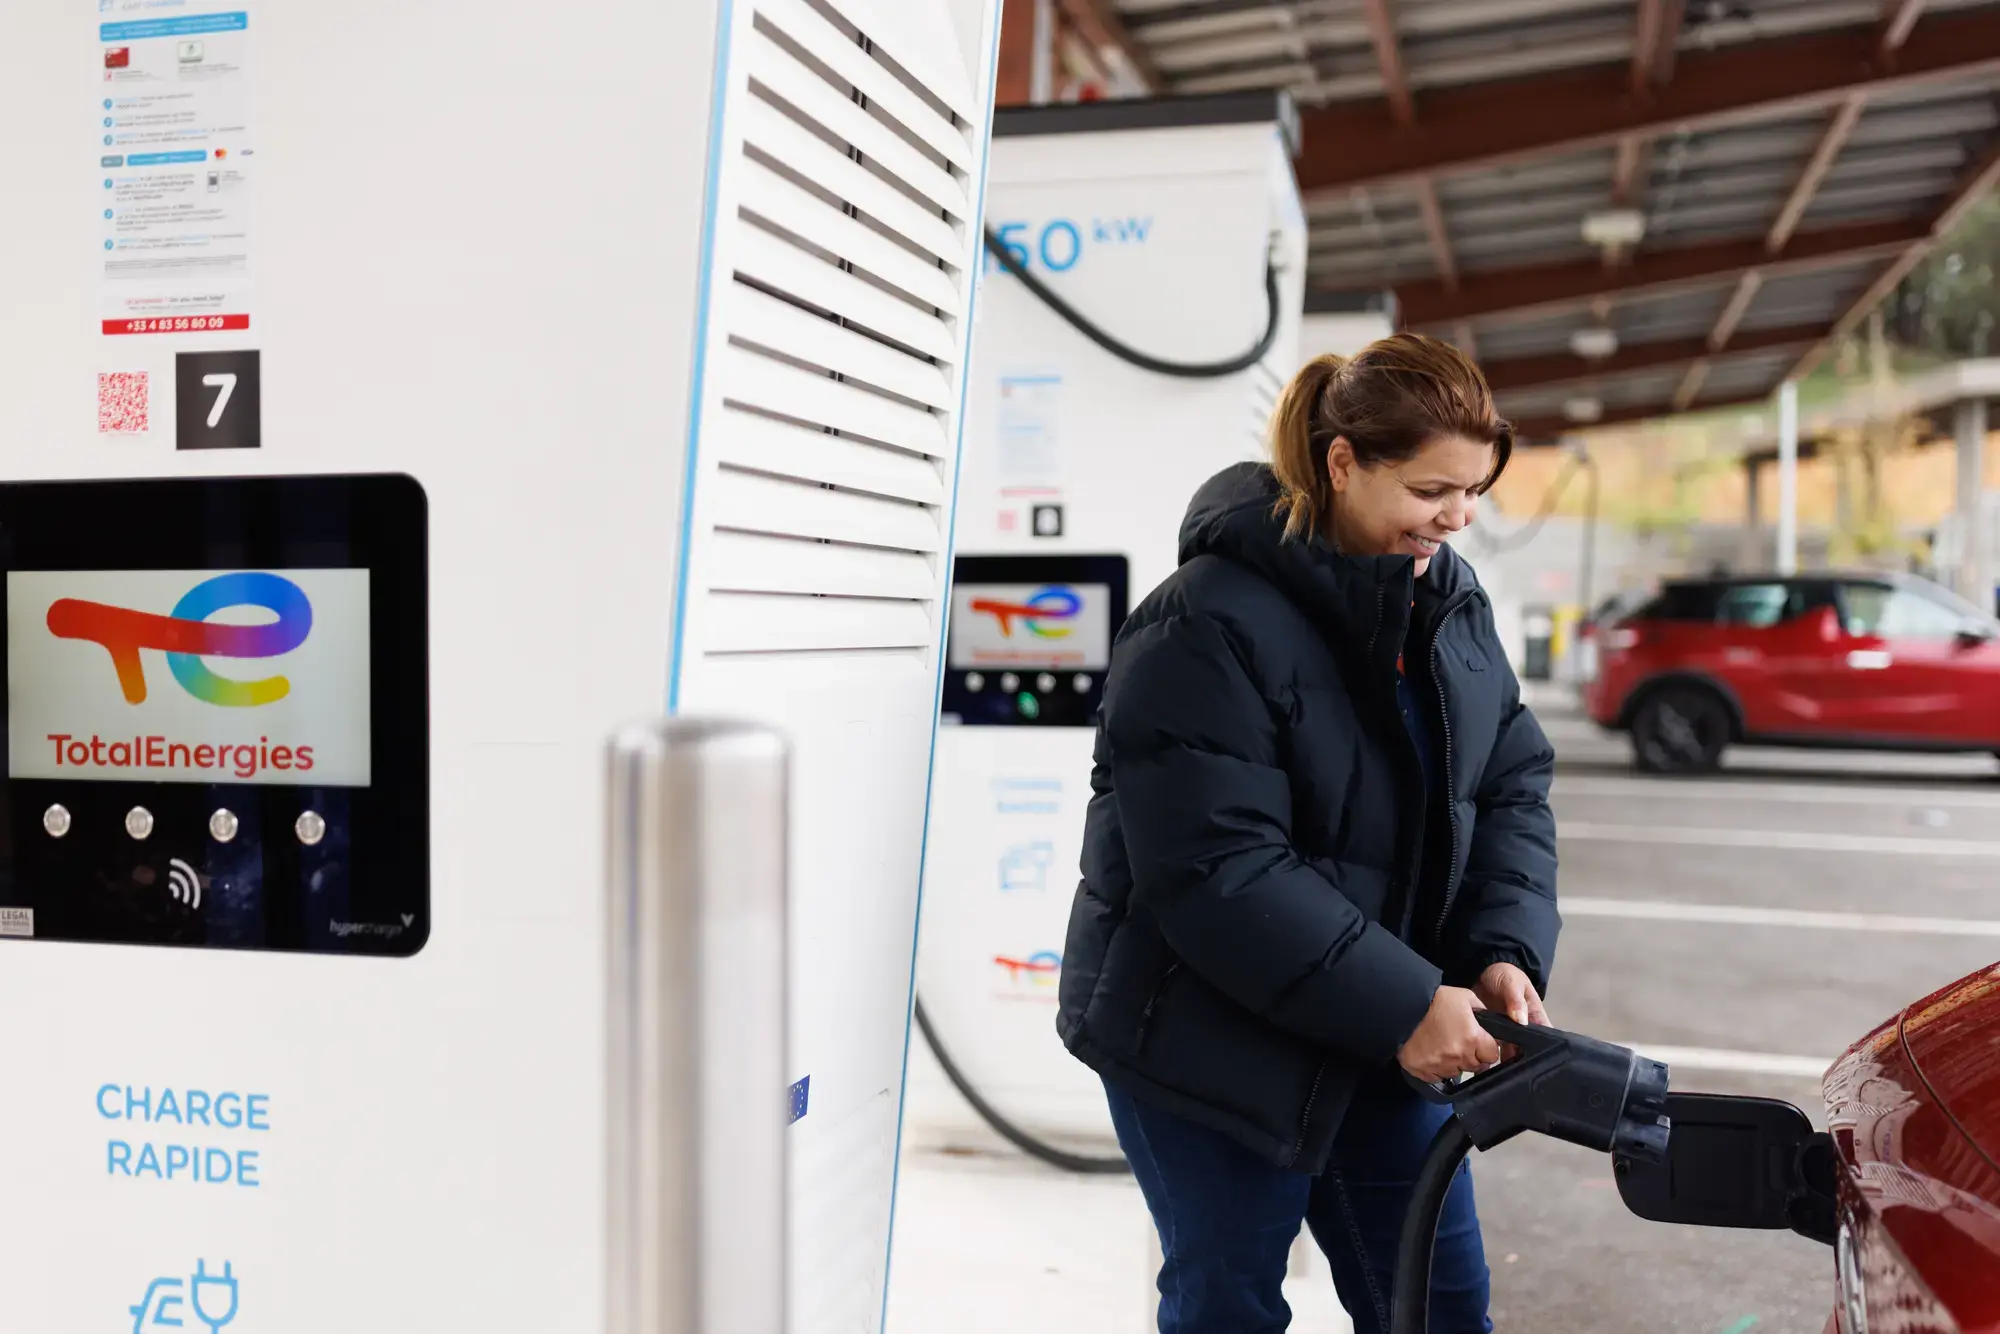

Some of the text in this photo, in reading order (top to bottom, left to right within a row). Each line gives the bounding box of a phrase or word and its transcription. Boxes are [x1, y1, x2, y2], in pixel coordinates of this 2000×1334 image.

[983, 219, 1081, 273] 50
[126, 319, 147, 331] +33
[148, 319, 156, 330] 4
[208, 315, 224, 328] 09
[202, 373, 237, 429] 7
[47, 734, 314, 778] TotalEnergies
[2, 910, 29, 921] LEGAL
[96, 1083, 270, 1131] CHARGE
[107, 1140, 260, 1187] RAPIDE
